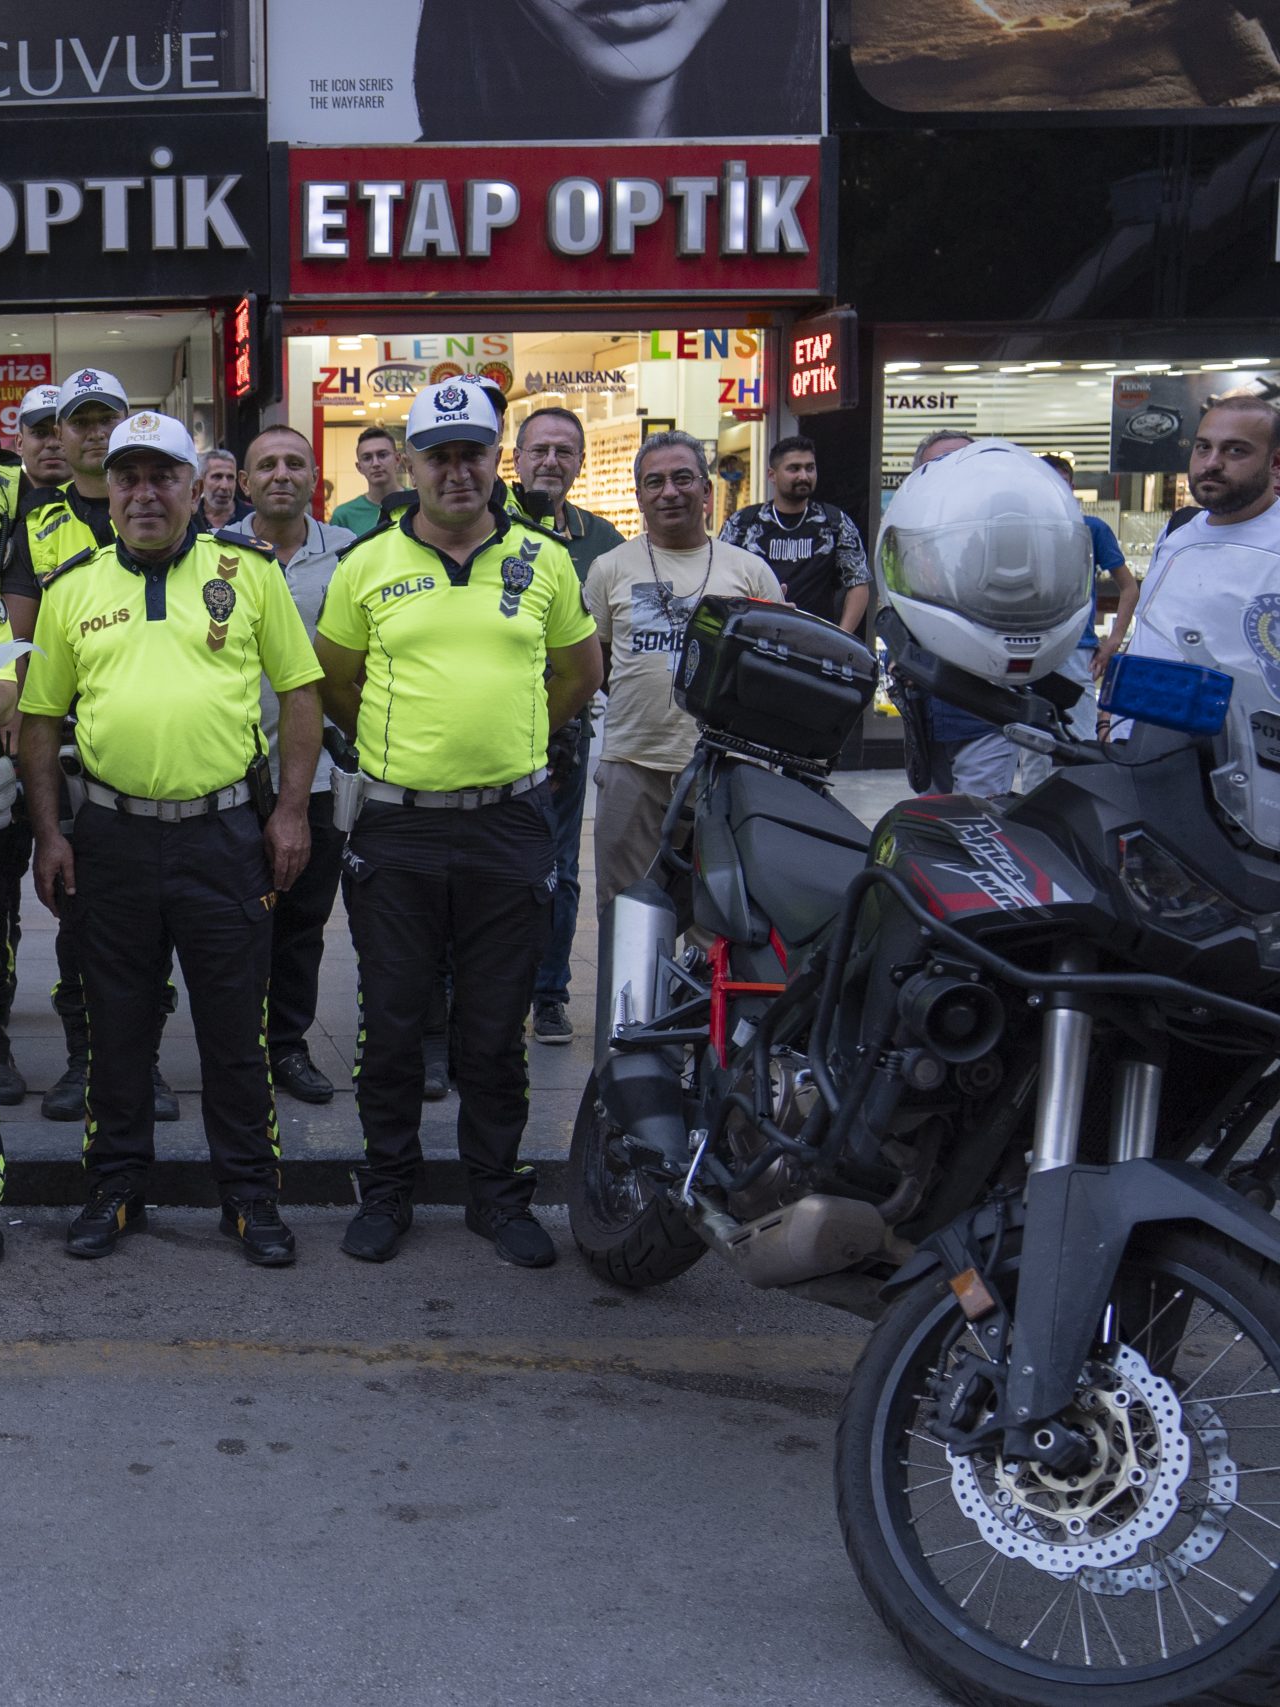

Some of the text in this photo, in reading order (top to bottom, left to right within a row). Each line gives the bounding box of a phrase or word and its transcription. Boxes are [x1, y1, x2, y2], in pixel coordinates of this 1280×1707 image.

[310, 78, 393, 92] THE ICON SERIES
[310, 95, 384, 109] THE WAYFARER
[301, 158, 811, 260] ETAP OPTİK
[383, 335, 509, 361] LENS
[651, 328, 758, 360] LENS
[794, 333, 832, 366] ETAP
[546, 370, 626, 384] HALKBANK
[792, 363, 837, 397] OPTİK
[886, 391, 958, 410] TAKSİT
